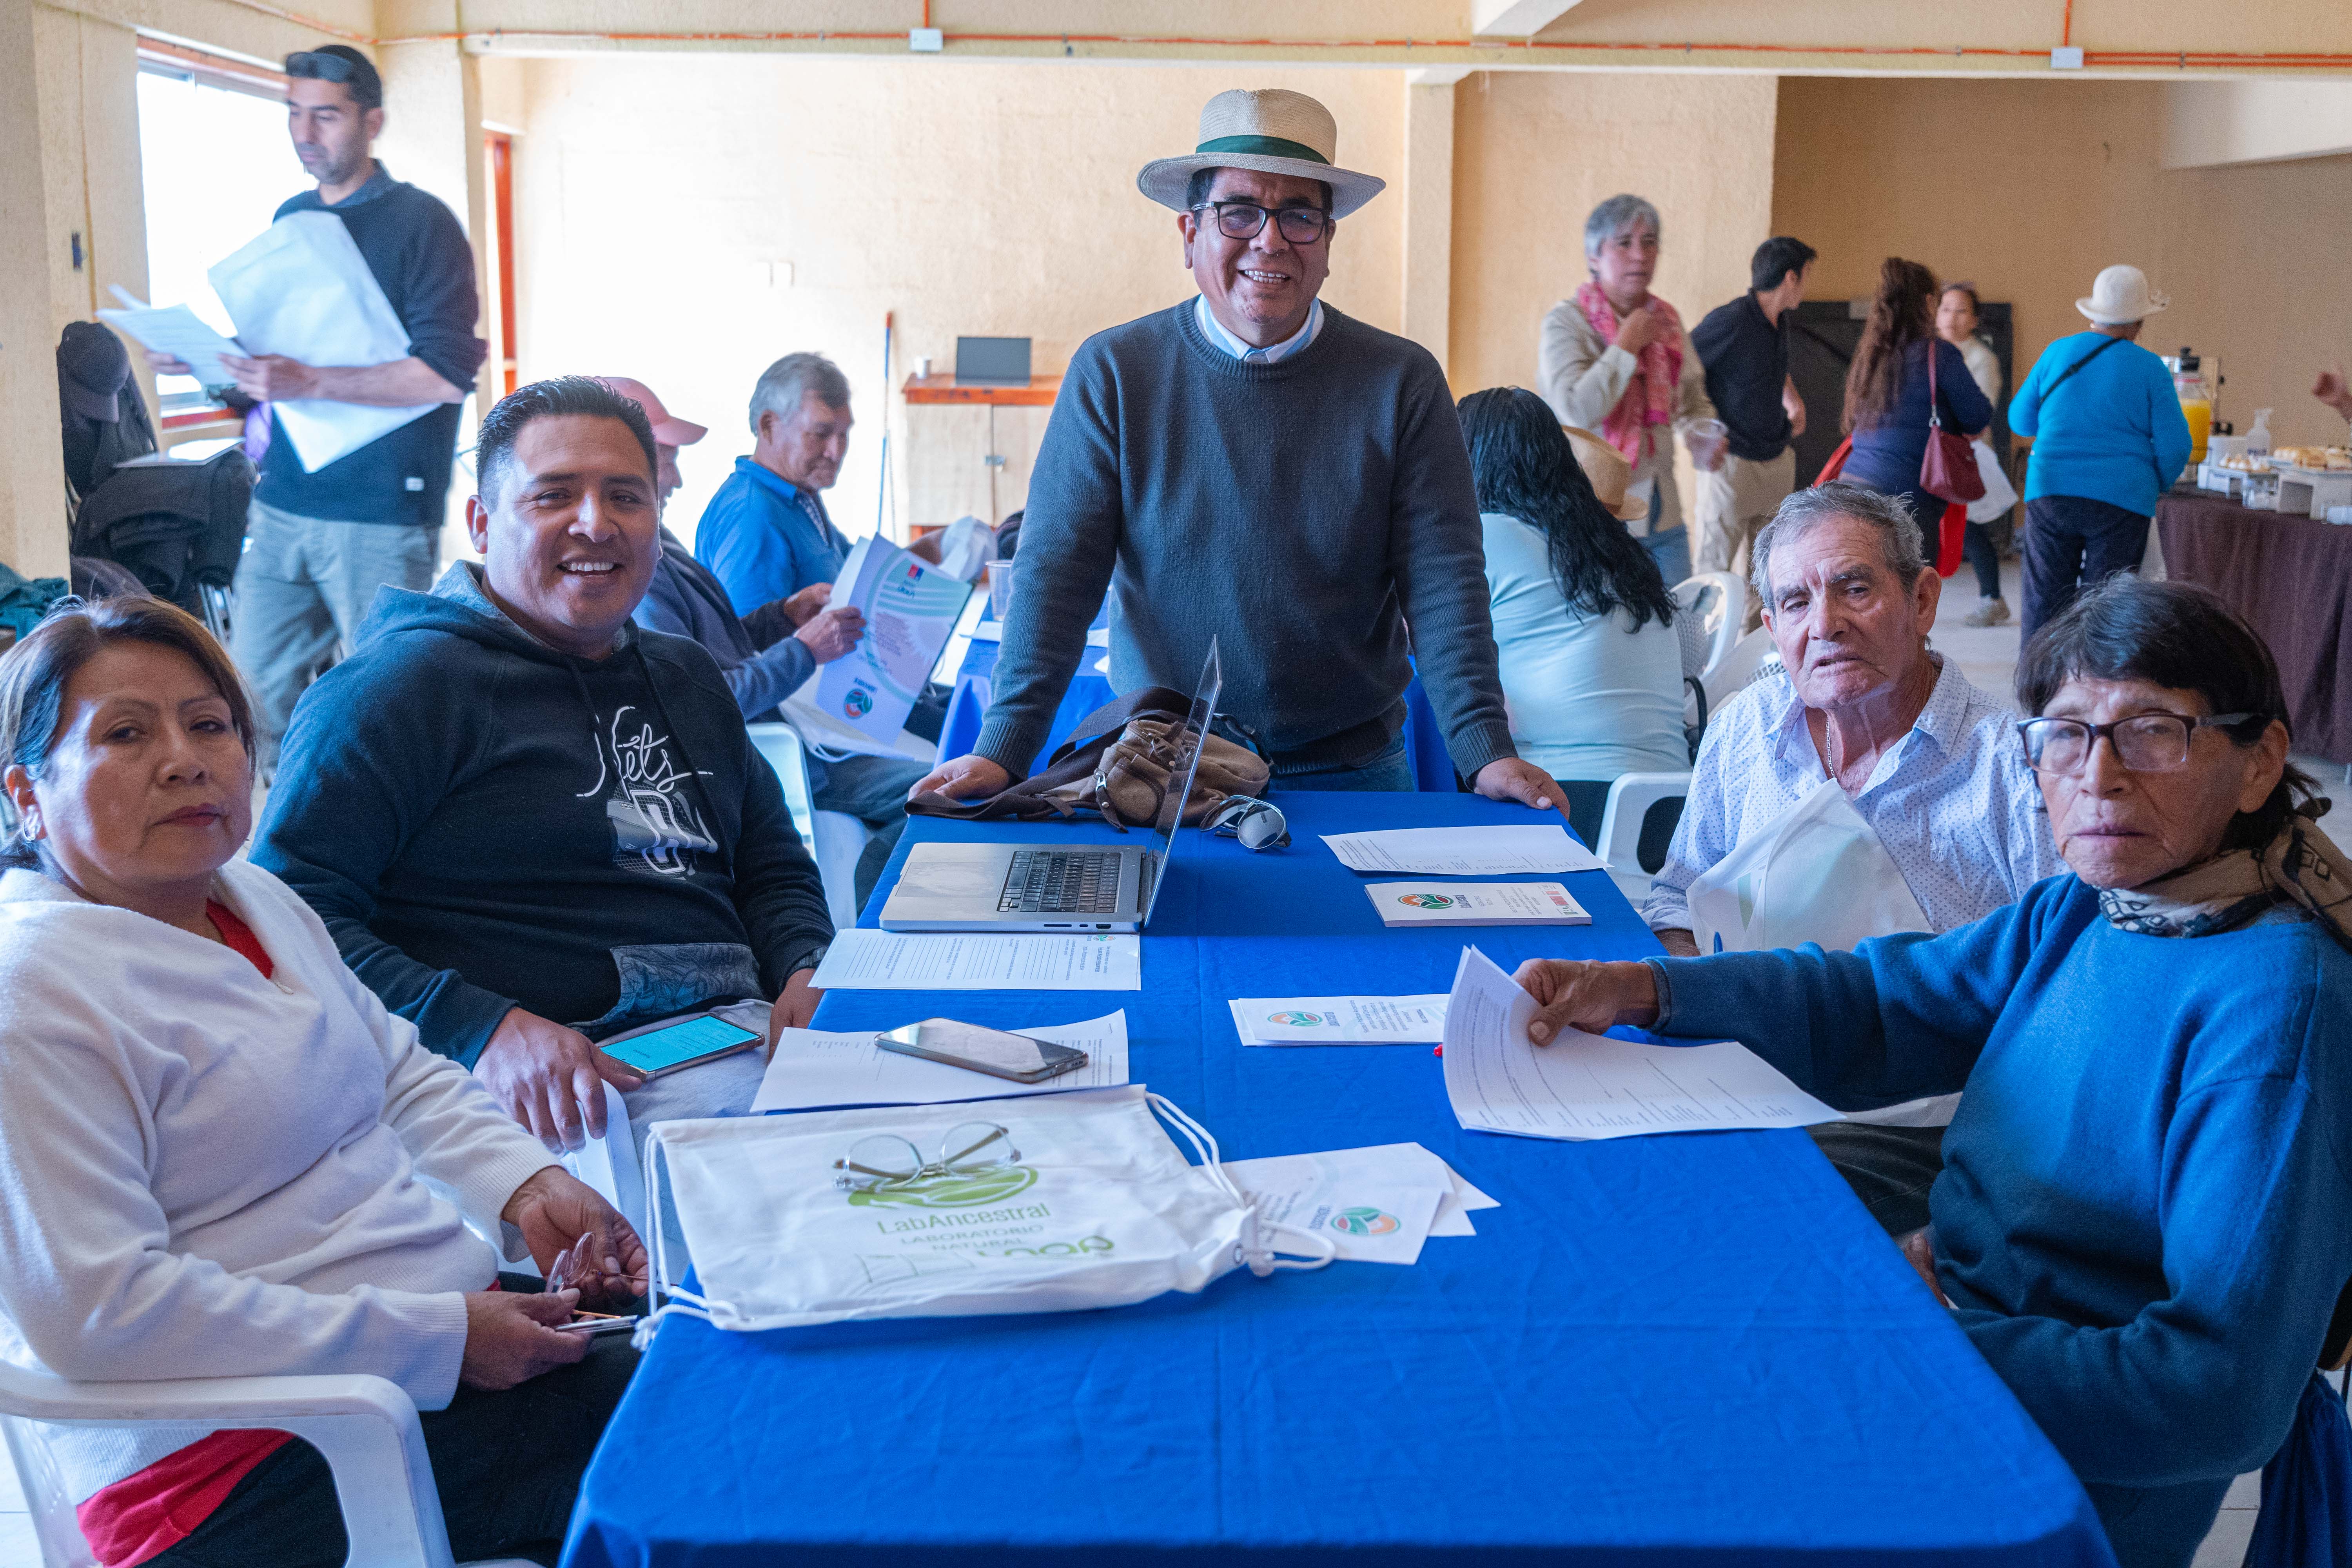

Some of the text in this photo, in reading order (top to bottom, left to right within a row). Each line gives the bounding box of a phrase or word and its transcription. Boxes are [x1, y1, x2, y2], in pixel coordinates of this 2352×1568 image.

[877, 1202, 1051, 1234] LabAncestral
[900, 1224, 1044, 1244] LABORATORIO
[932, 1238, 1029, 1251] NATURAL
